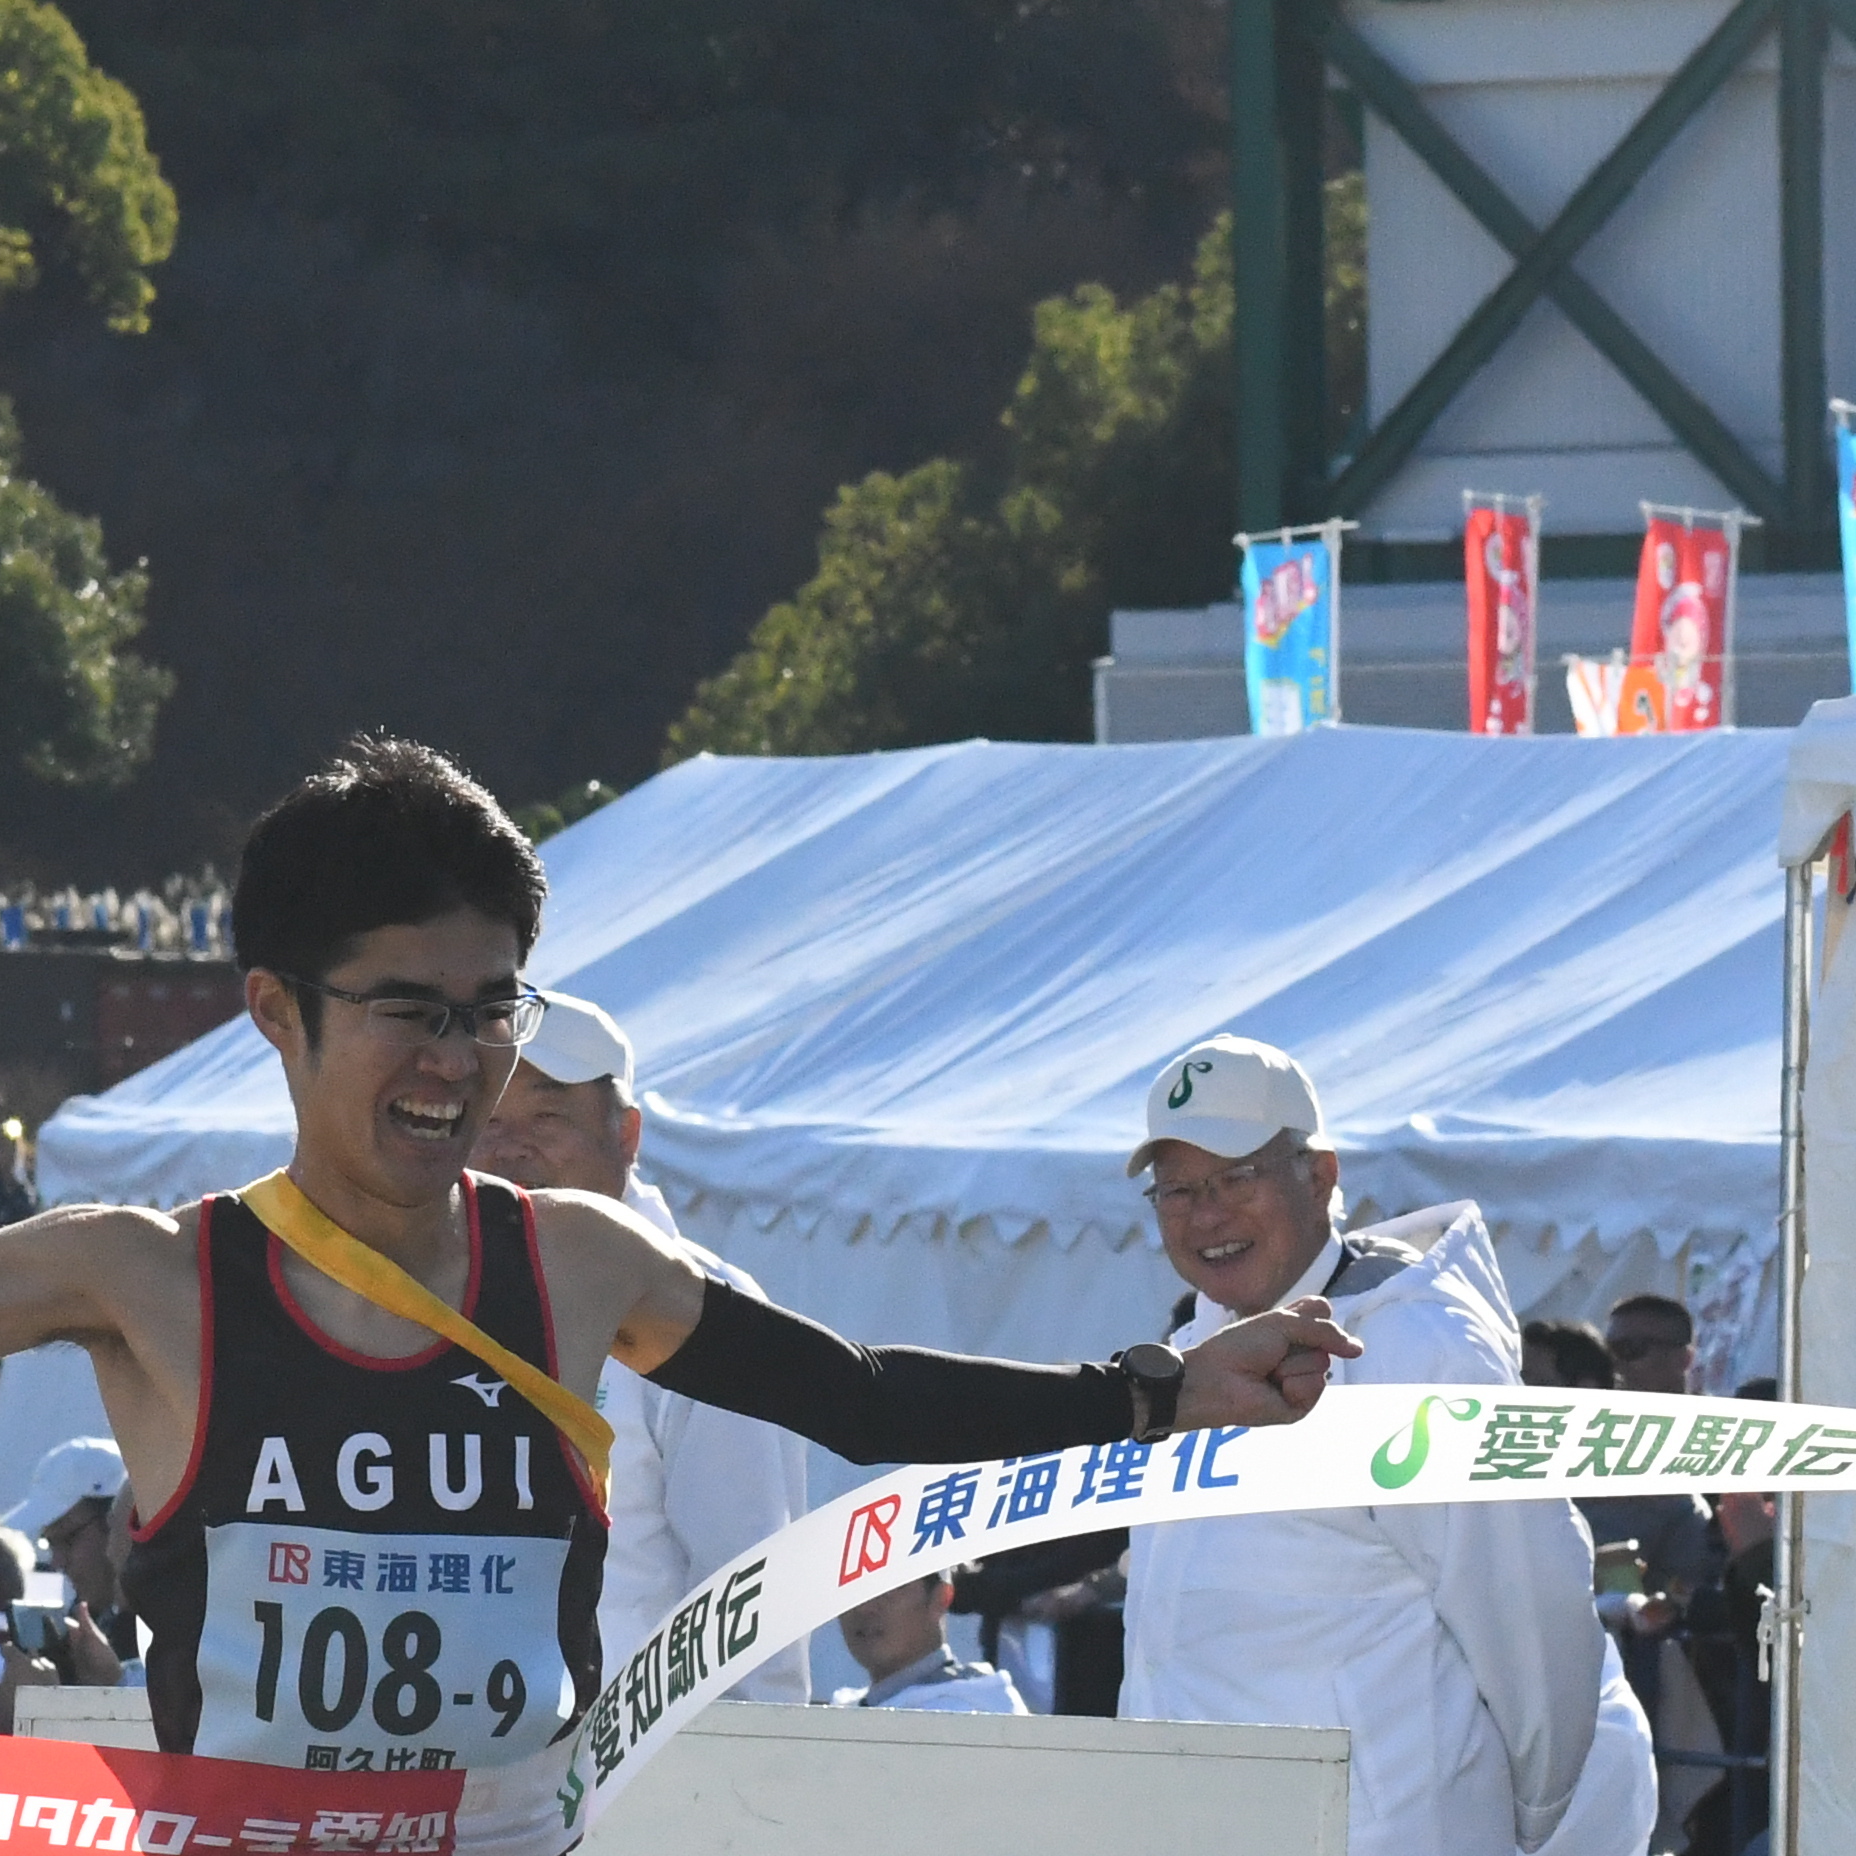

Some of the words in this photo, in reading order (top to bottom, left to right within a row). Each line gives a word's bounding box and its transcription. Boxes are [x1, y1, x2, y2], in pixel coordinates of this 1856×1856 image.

[246, 1431, 534, 1513] AGUI
[908, 1425, 1251, 1557] 東海理化
[323, 1549, 517, 1595] 東海理化
[254, 1600, 528, 1738] 108-9
[590, 1556, 768, 1790] 愛知駅伝
